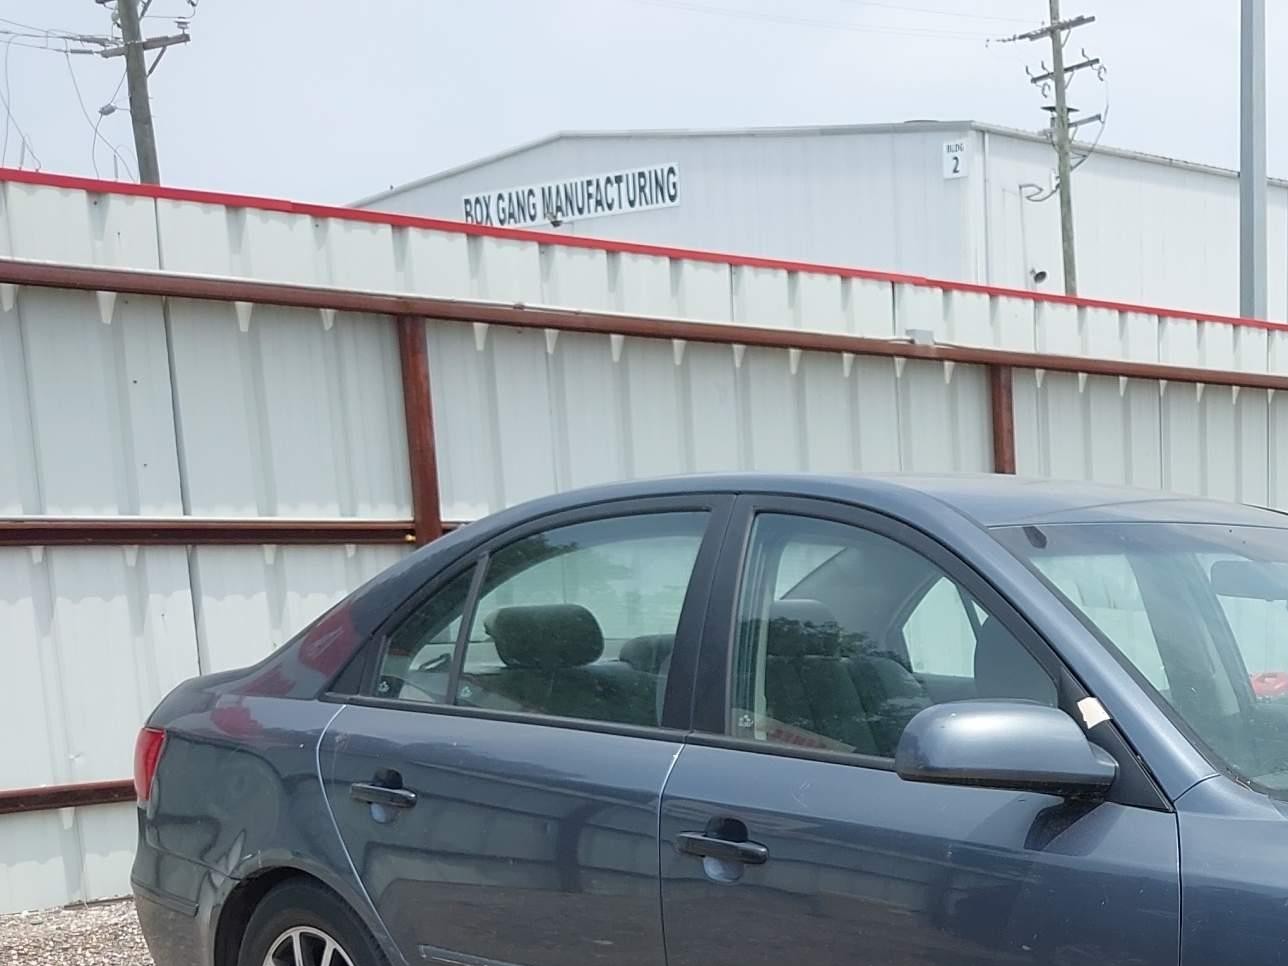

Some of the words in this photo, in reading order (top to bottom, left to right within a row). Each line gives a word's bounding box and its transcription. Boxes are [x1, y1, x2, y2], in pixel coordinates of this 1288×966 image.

[952, 155, 961, 173] 2
[464, 196, 495, 226] BOX
[496, 189, 538, 225] GANG
[541, 166, 679, 219] MANUFACTURING
